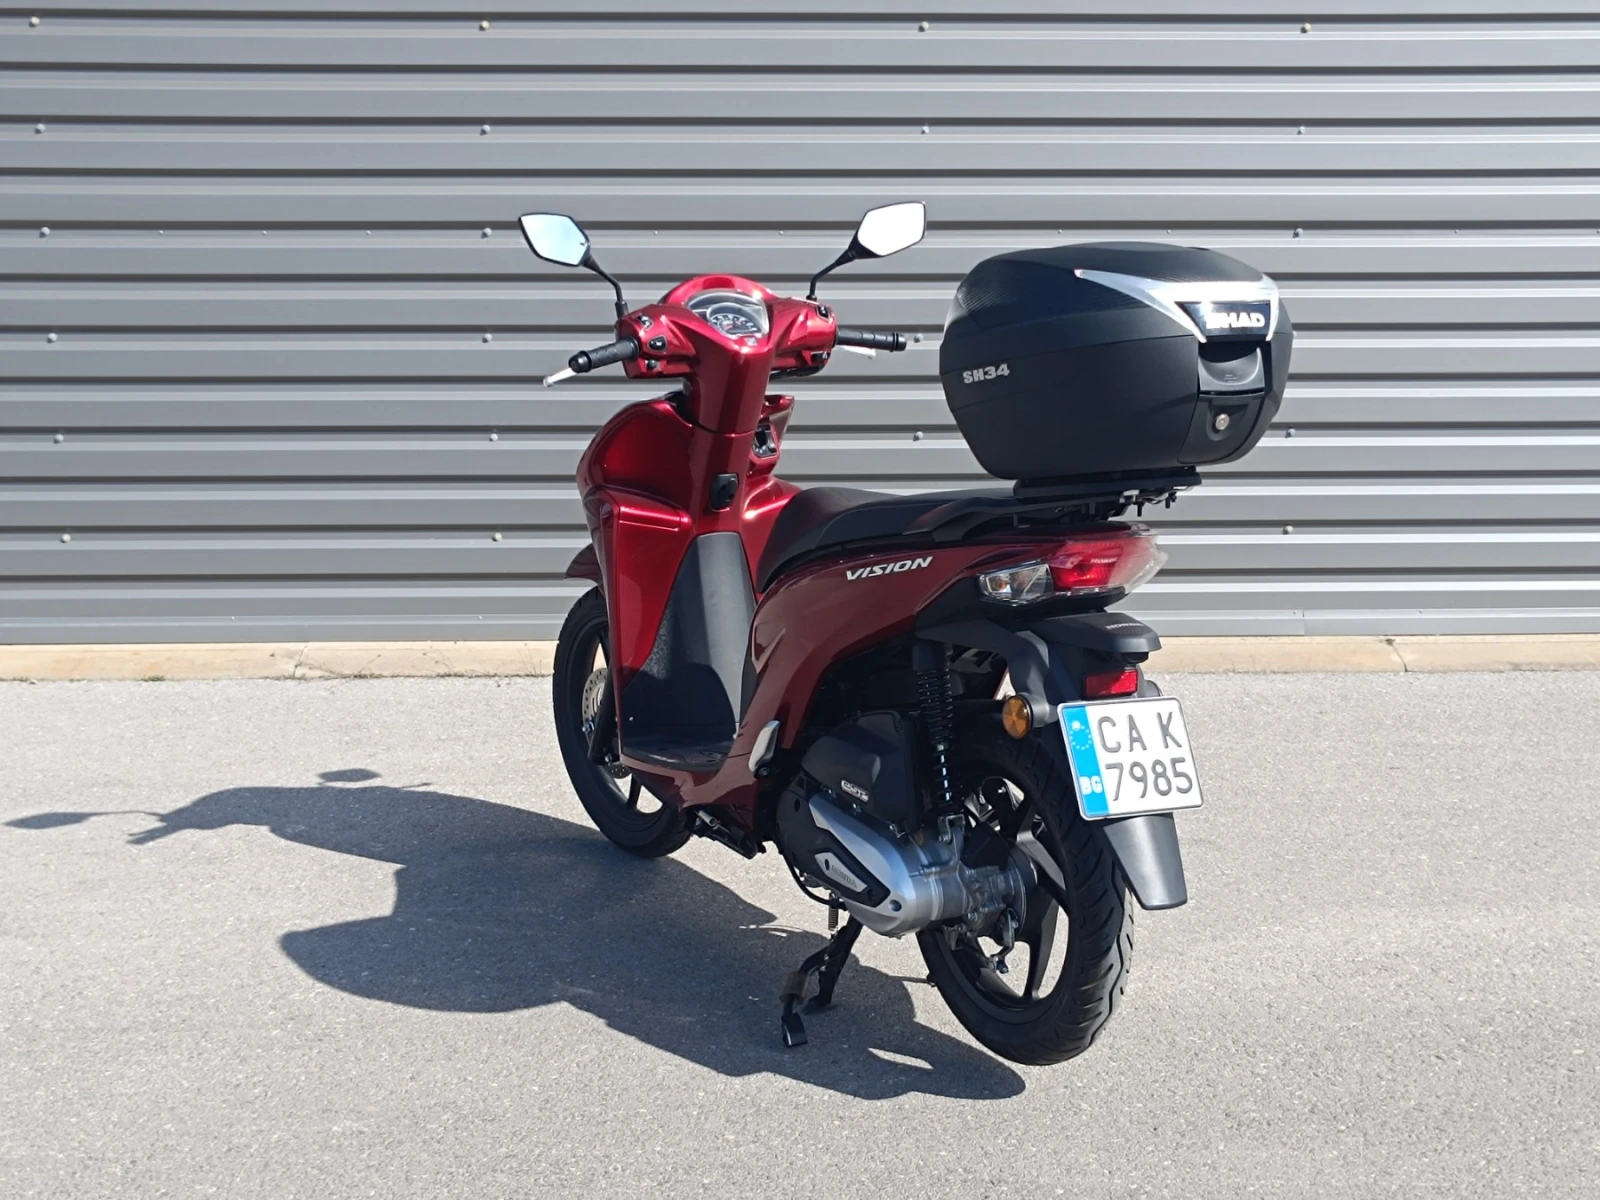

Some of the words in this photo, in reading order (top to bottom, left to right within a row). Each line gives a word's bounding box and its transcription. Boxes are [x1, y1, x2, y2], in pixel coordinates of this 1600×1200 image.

[962, 363, 1010, 384] SH34
[846, 556, 934, 580] VISION
[1079, 774, 1103, 795] BG
[1105, 757, 1193, 801] 7985
